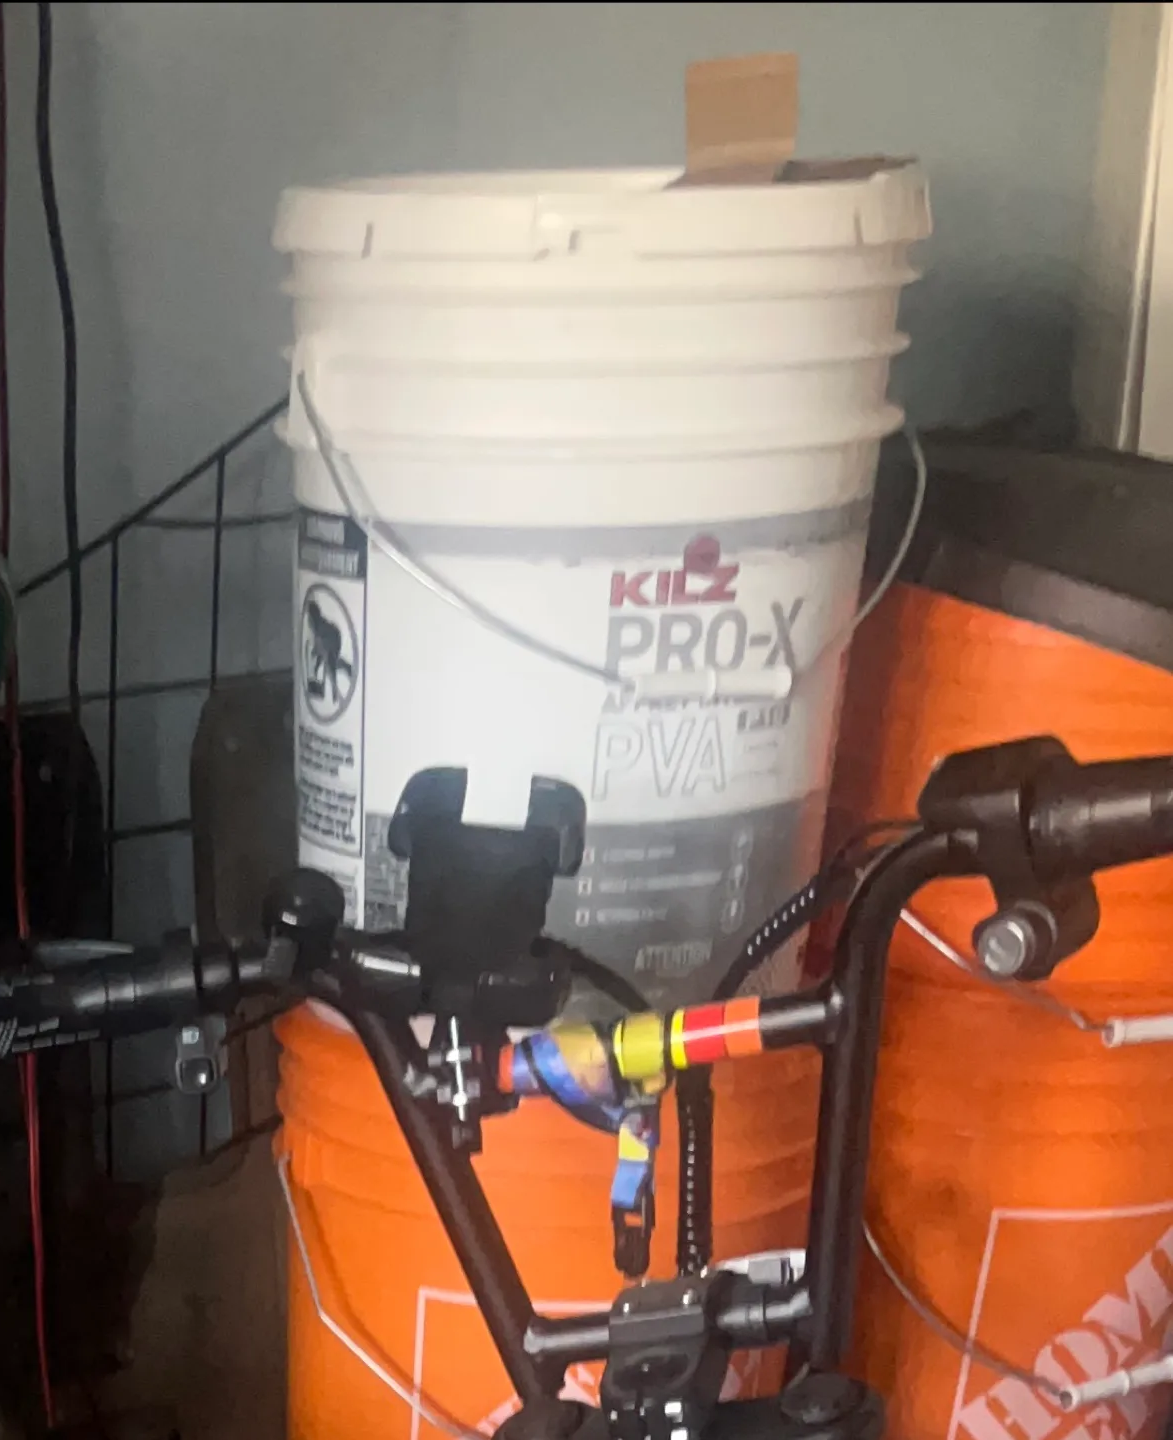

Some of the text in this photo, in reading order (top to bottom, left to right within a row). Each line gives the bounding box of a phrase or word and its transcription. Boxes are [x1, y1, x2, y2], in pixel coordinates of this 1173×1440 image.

[609, 562, 740, 608] KILZ
[605, 597, 804, 682] PRO-X
[591, 714, 727, 801] PVA
